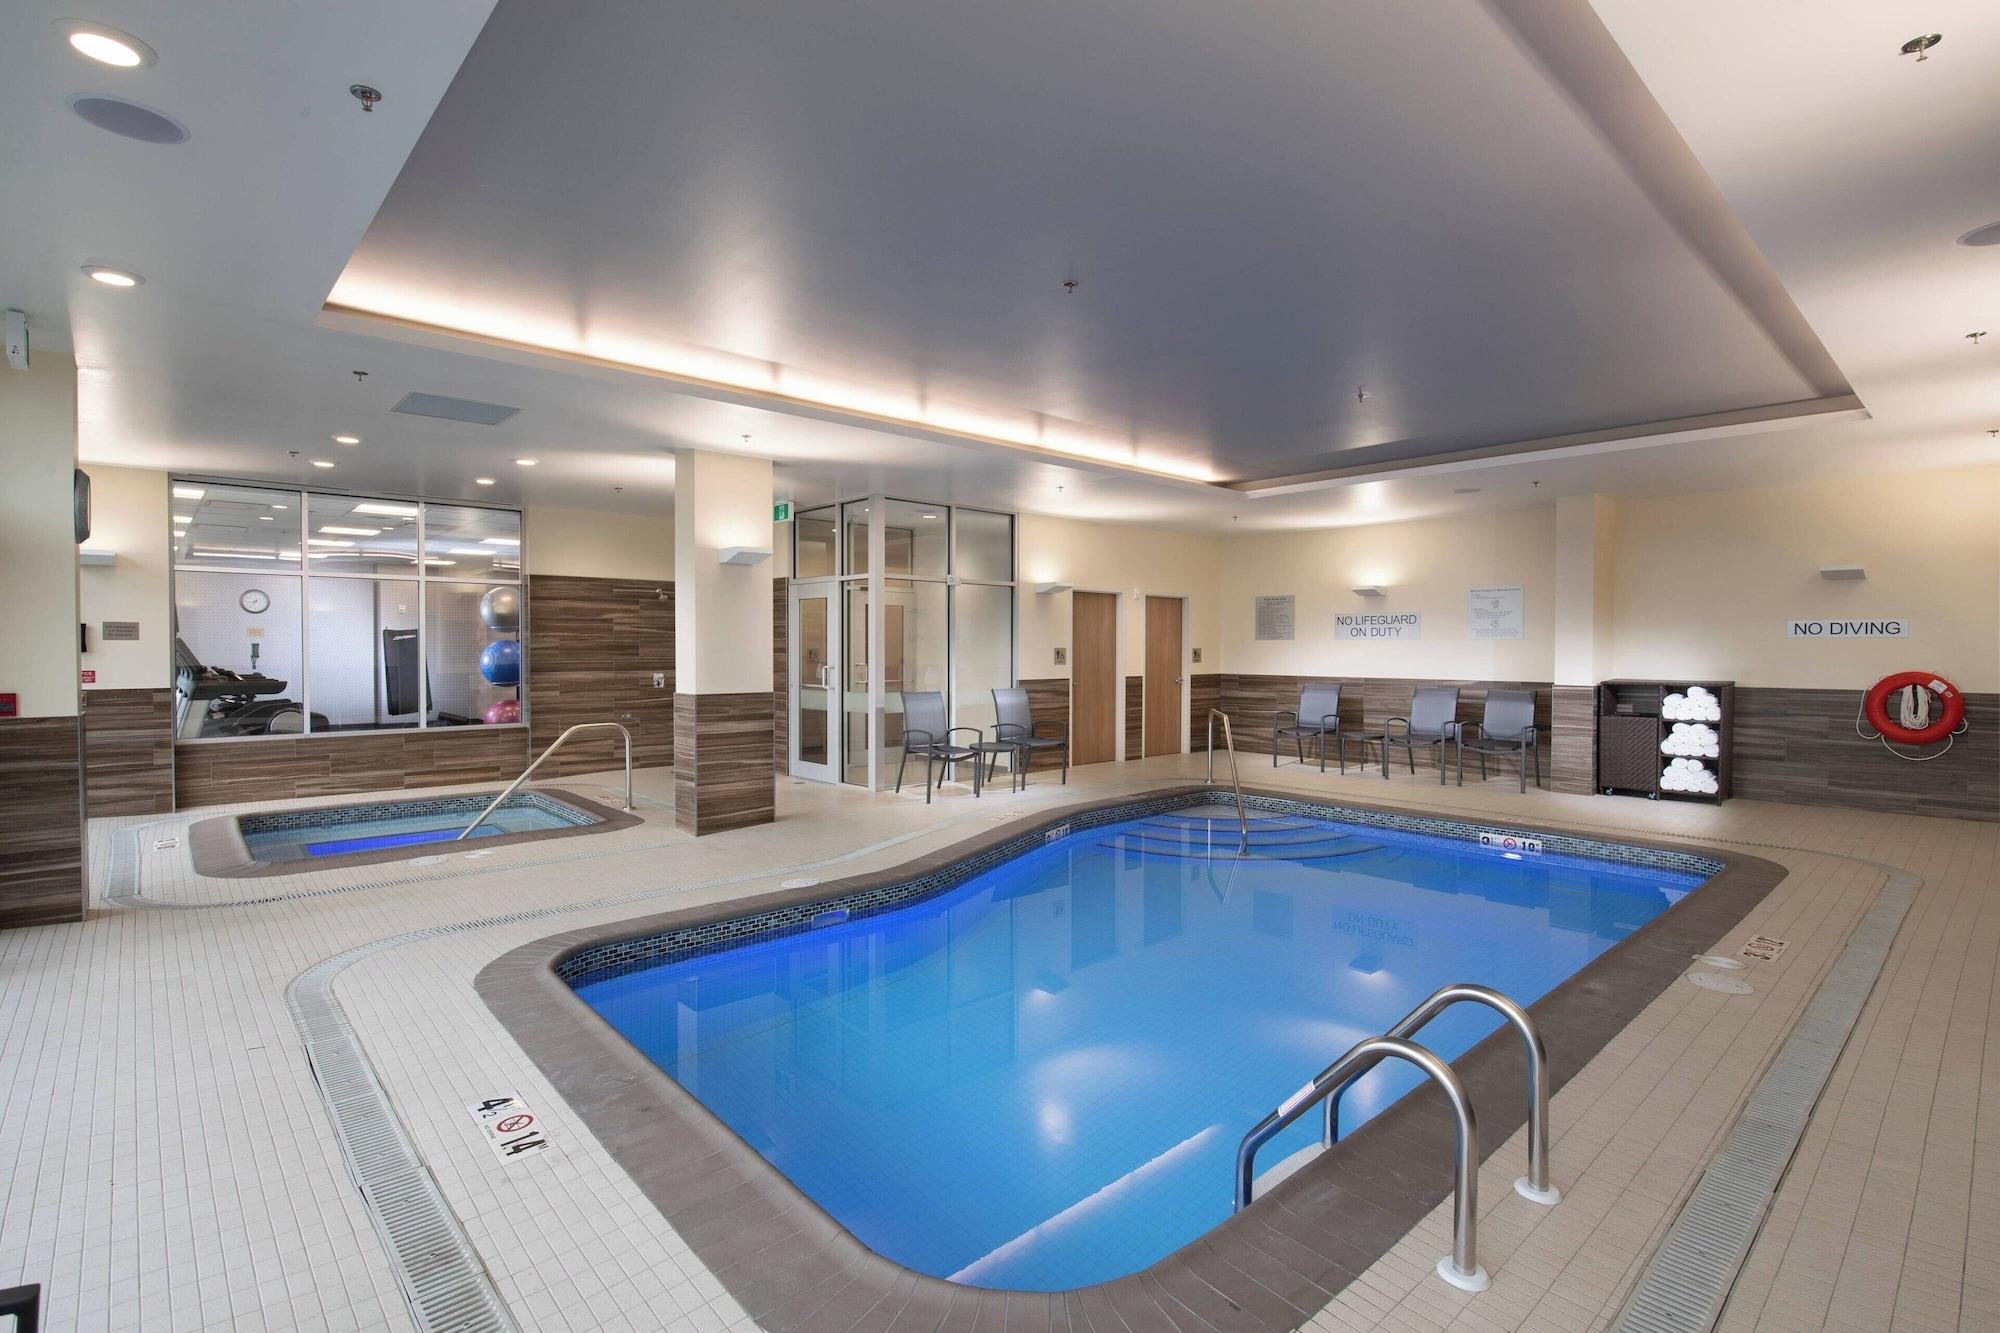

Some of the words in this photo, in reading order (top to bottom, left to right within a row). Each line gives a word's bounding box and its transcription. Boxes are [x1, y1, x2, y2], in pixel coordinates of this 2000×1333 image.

[1336, 616, 1353, 626] NO
[1355, 614, 1417, 626] LIFEGUARD
[1350, 627, 1367, 637] ON
[1370, 627, 1402, 637] DUTY
[1794, 622, 1823, 635] NO
[1829, 621, 1901, 635] DIVING
